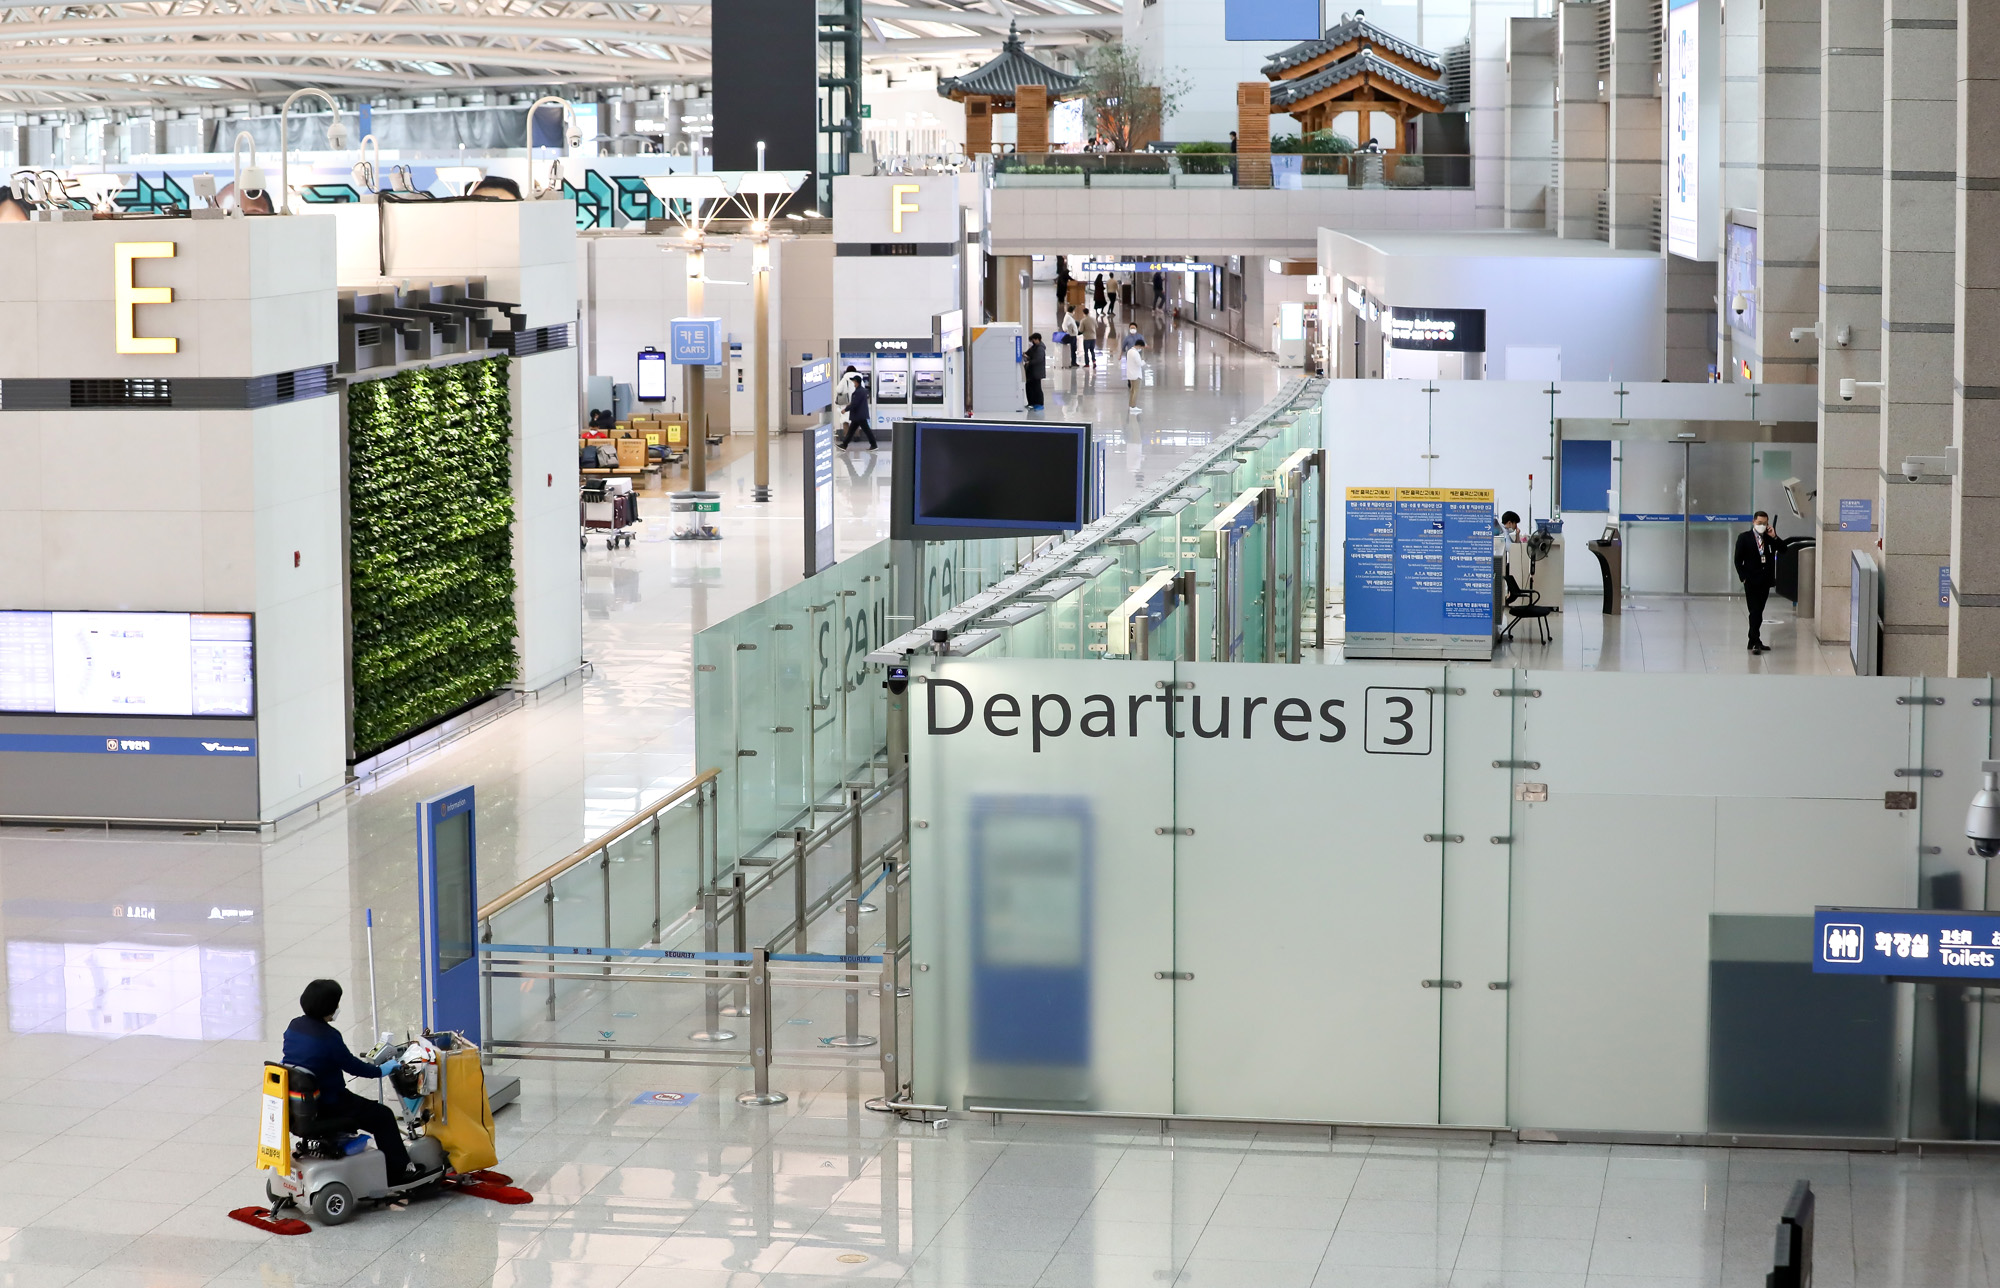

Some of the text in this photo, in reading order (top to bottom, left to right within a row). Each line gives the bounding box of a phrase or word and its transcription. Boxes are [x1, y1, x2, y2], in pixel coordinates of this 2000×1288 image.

[892, 184, 919, 234] F
[115, 241, 178, 354] E
[680, 330, 706, 344] 카트
[679, 346, 706, 354] CARTS
[926, 678, 1414, 753] Departures 3
[447, 798, 467, 812] Information
[1874, 931, 1930, 958] 화장실
[664, 950, 696, 959] SECURITY
[840, 955, 871, 963] SECURITY
[1938, 949, 1995, 967] Toilets
